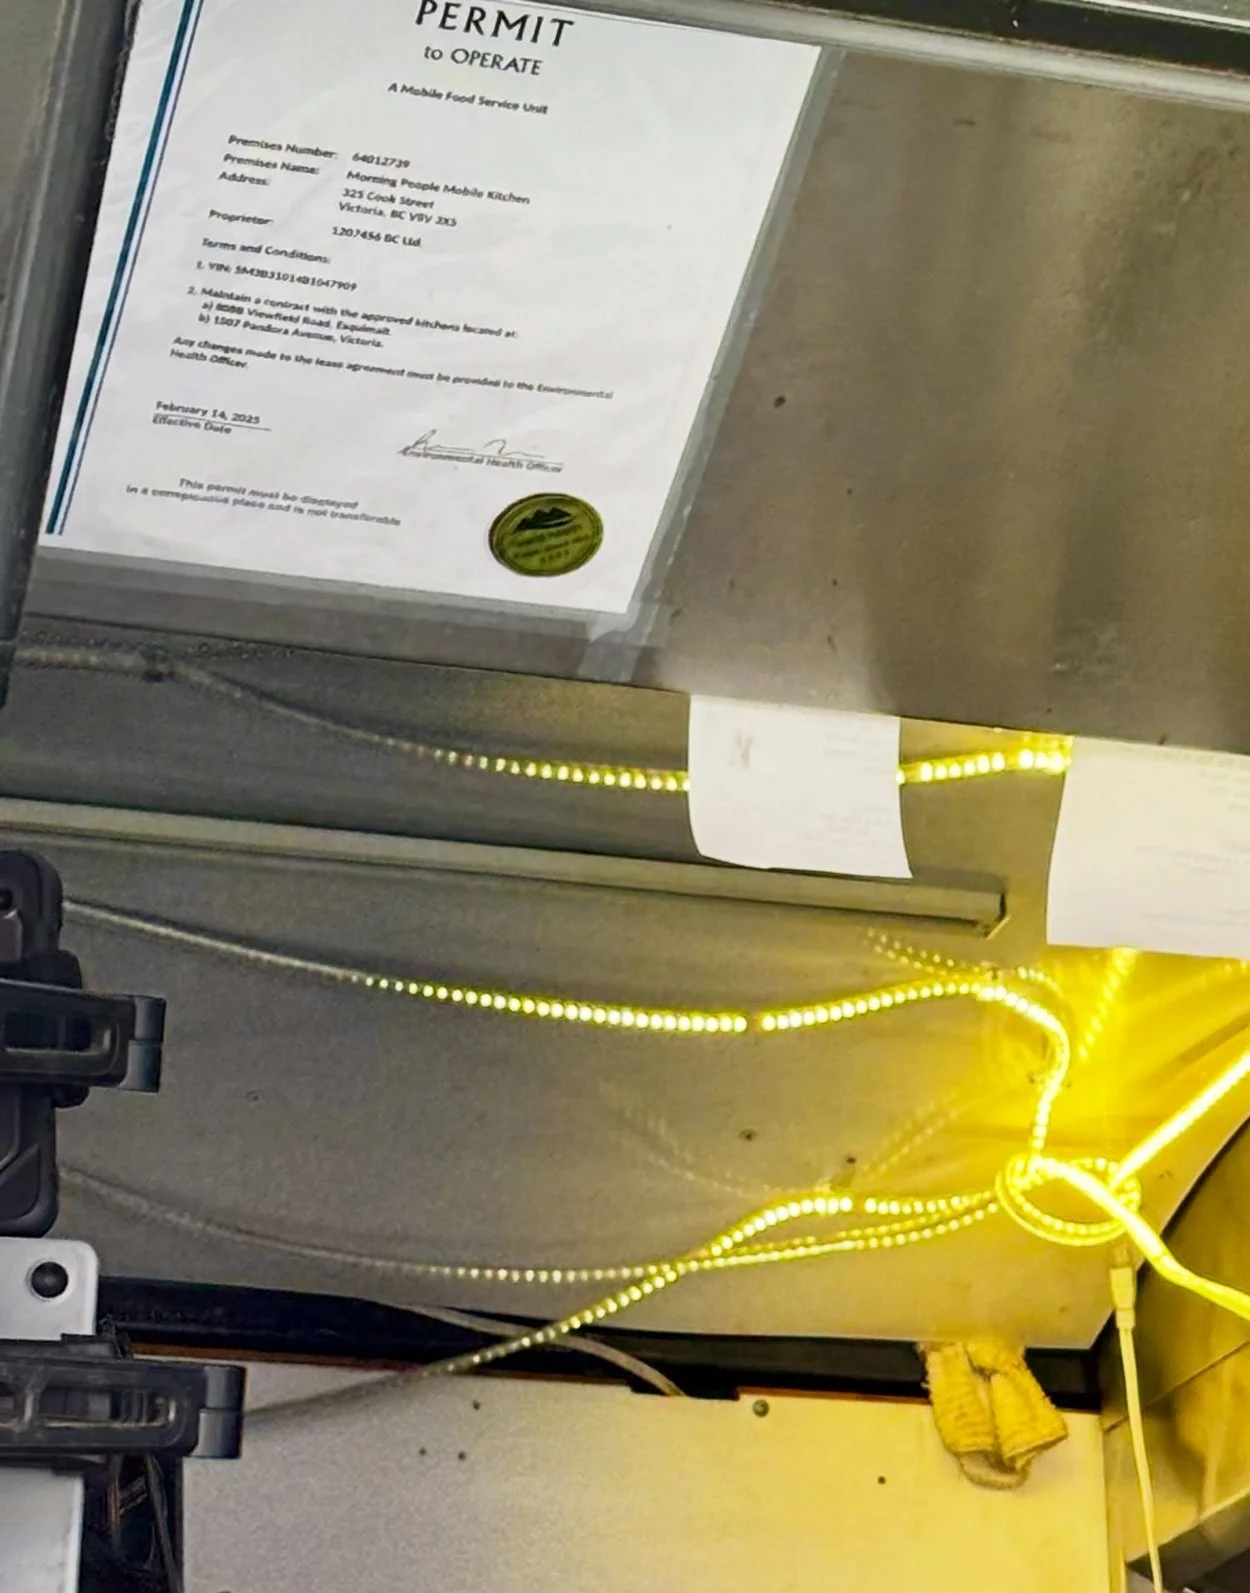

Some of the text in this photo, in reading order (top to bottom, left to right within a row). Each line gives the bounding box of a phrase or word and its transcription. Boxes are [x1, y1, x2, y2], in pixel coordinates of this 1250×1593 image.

[415, 0, 575, 47] PERMIT
[424, 46, 543, 76] to OPERATE
[388, 82, 549, 115] A Mobile Food Service Unit
[228, 134, 282, 151] Premises
[223, 153, 278, 169] Premises
[346, 170, 531, 205] Morning People Mobile Kitchen
[367, 191, 396, 204] Cook
[399, 196, 435, 209] Street
[390, 209, 407, 220] BC
[202, 237, 236, 251] Terms
[240, 244, 263, 254] and
[201, 287, 252, 302] Maintain
[263, 299, 310, 312] contract
[313, 305, 338, 316] with
[340, 308, 359, 319] the
[361, 312, 414, 326] approved
[415, 318, 460, 332] kitchens
[463, 323, 503, 338] located
[247, 308, 300, 323] Viewfield
[243, 320, 290, 336] Pandora
[169, 348, 207, 363] Health
[173, 335, 196, 349] Any
[198, 339, 243, 356] changes
[245, 347, 277, 361] made
[279, 352, 292, 362] to
[294, 354, 313, 365] the
[315, 358, 343, 369] lease
[155, 400, 209, 417] February
[151, 414, 232, 435] Effective Date
[179, 477, 204, 491] This
[206, 482, 247, 496] permit
